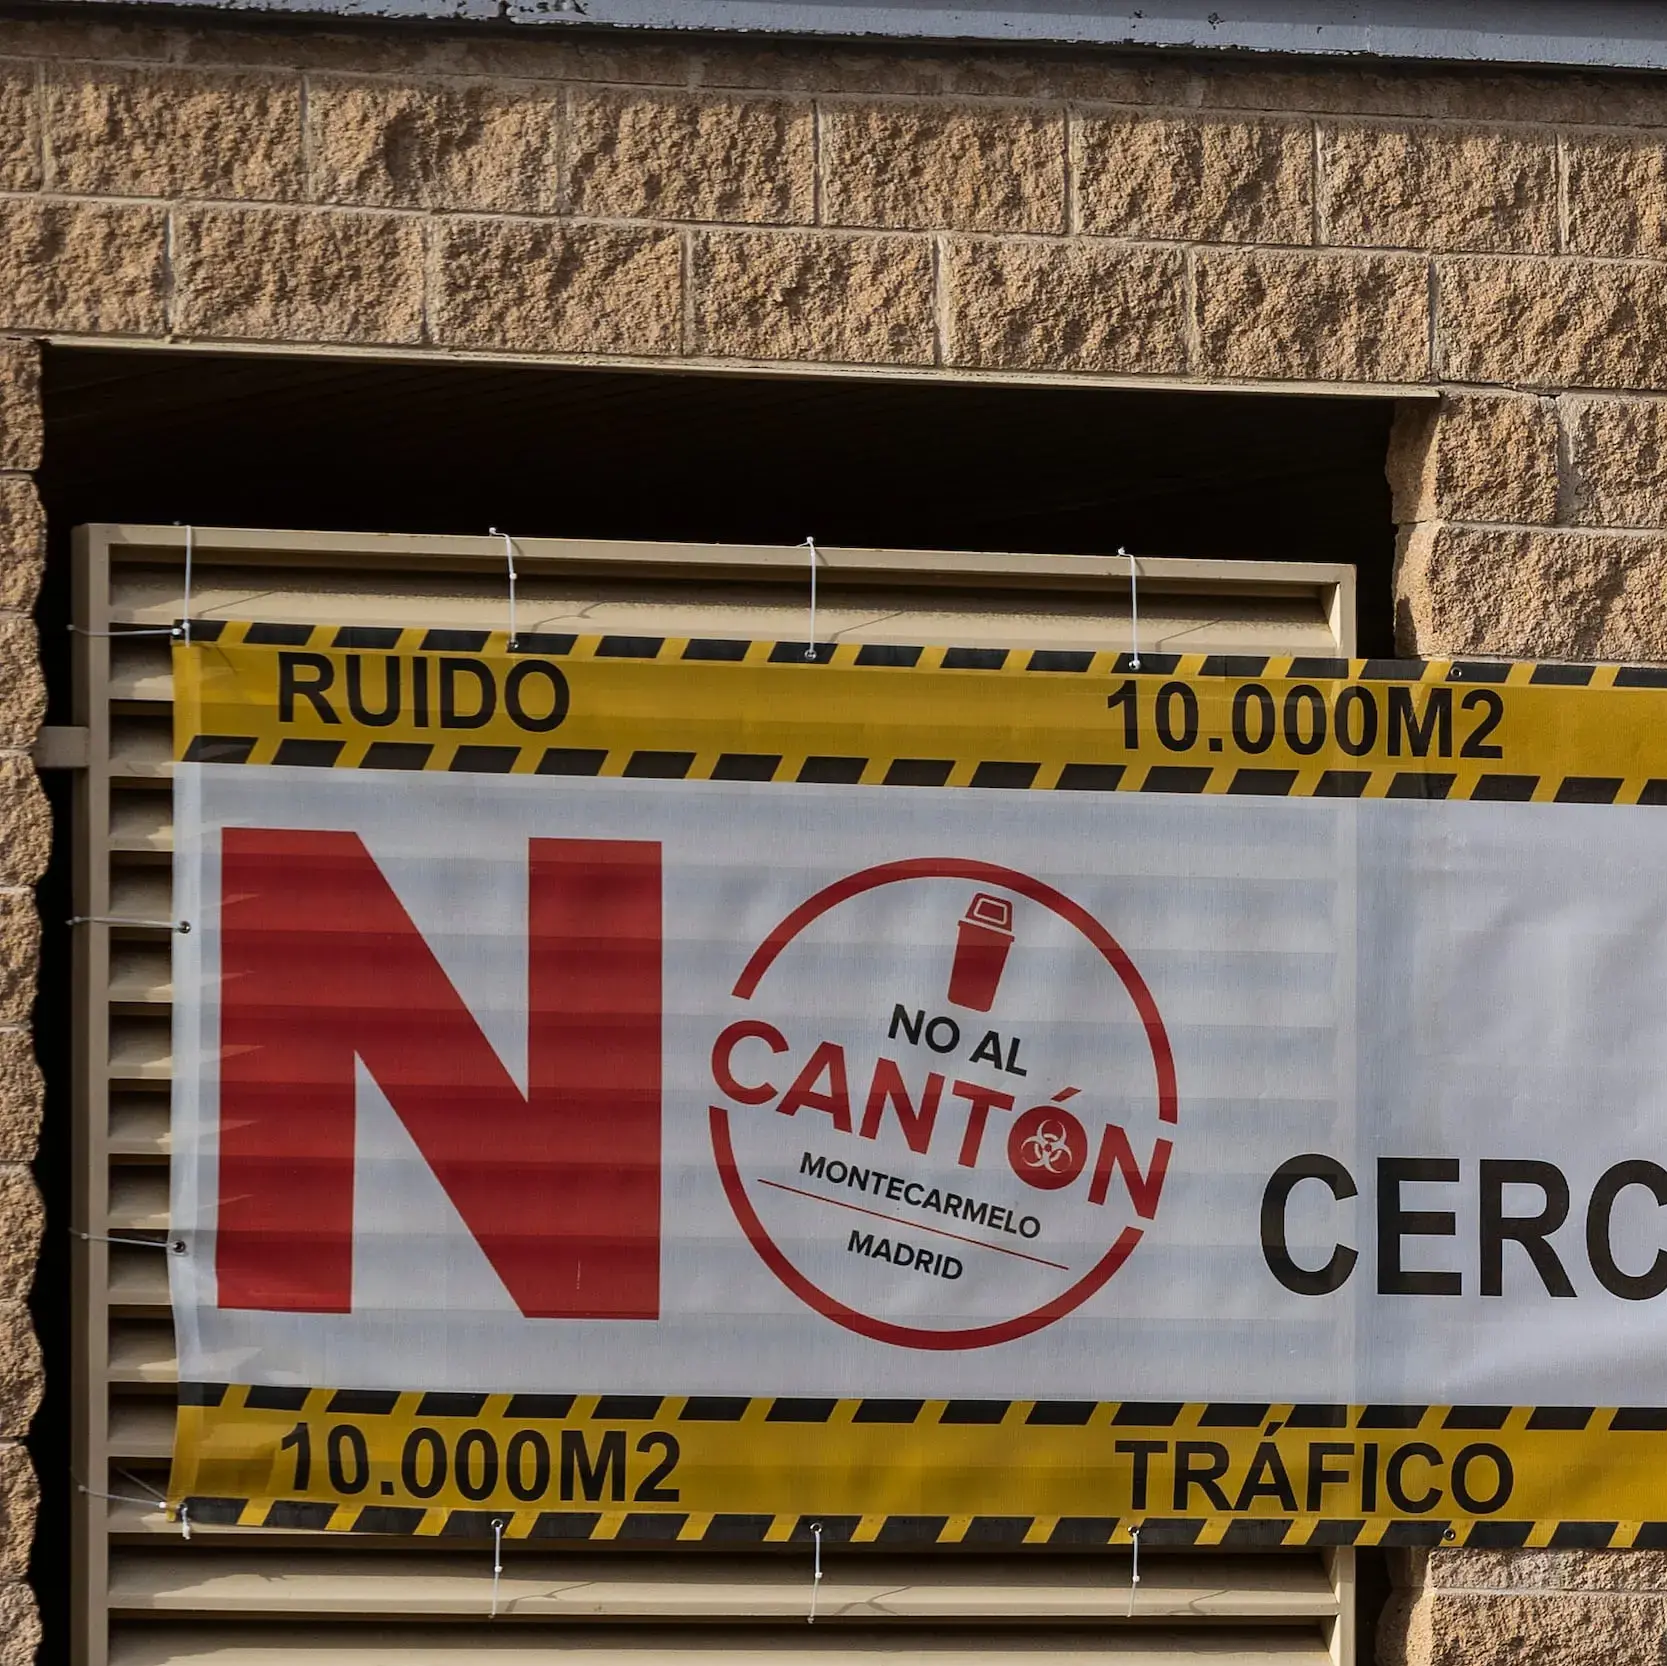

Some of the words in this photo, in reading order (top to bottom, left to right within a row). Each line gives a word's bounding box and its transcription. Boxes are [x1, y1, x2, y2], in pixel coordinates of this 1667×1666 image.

[277, 651, 570, 733] RUIDO
[1106, 679, 1505, 760] 10.000M2
[215, 826, 663, 1321] N
[887, 1003, 961, 1054] NO
[968, 1030, 1028, 1077] AL
[711, 1020, 1174, 1221] CANTÓN
[799, 1151, 1041, 1239] MONTECARMELO
[846, 1230, 963, 1281] MADRID
[279, 1421, 682, 1504] 10.000M2
[1114, 1421, 1515, 1515] TRÁFICO
